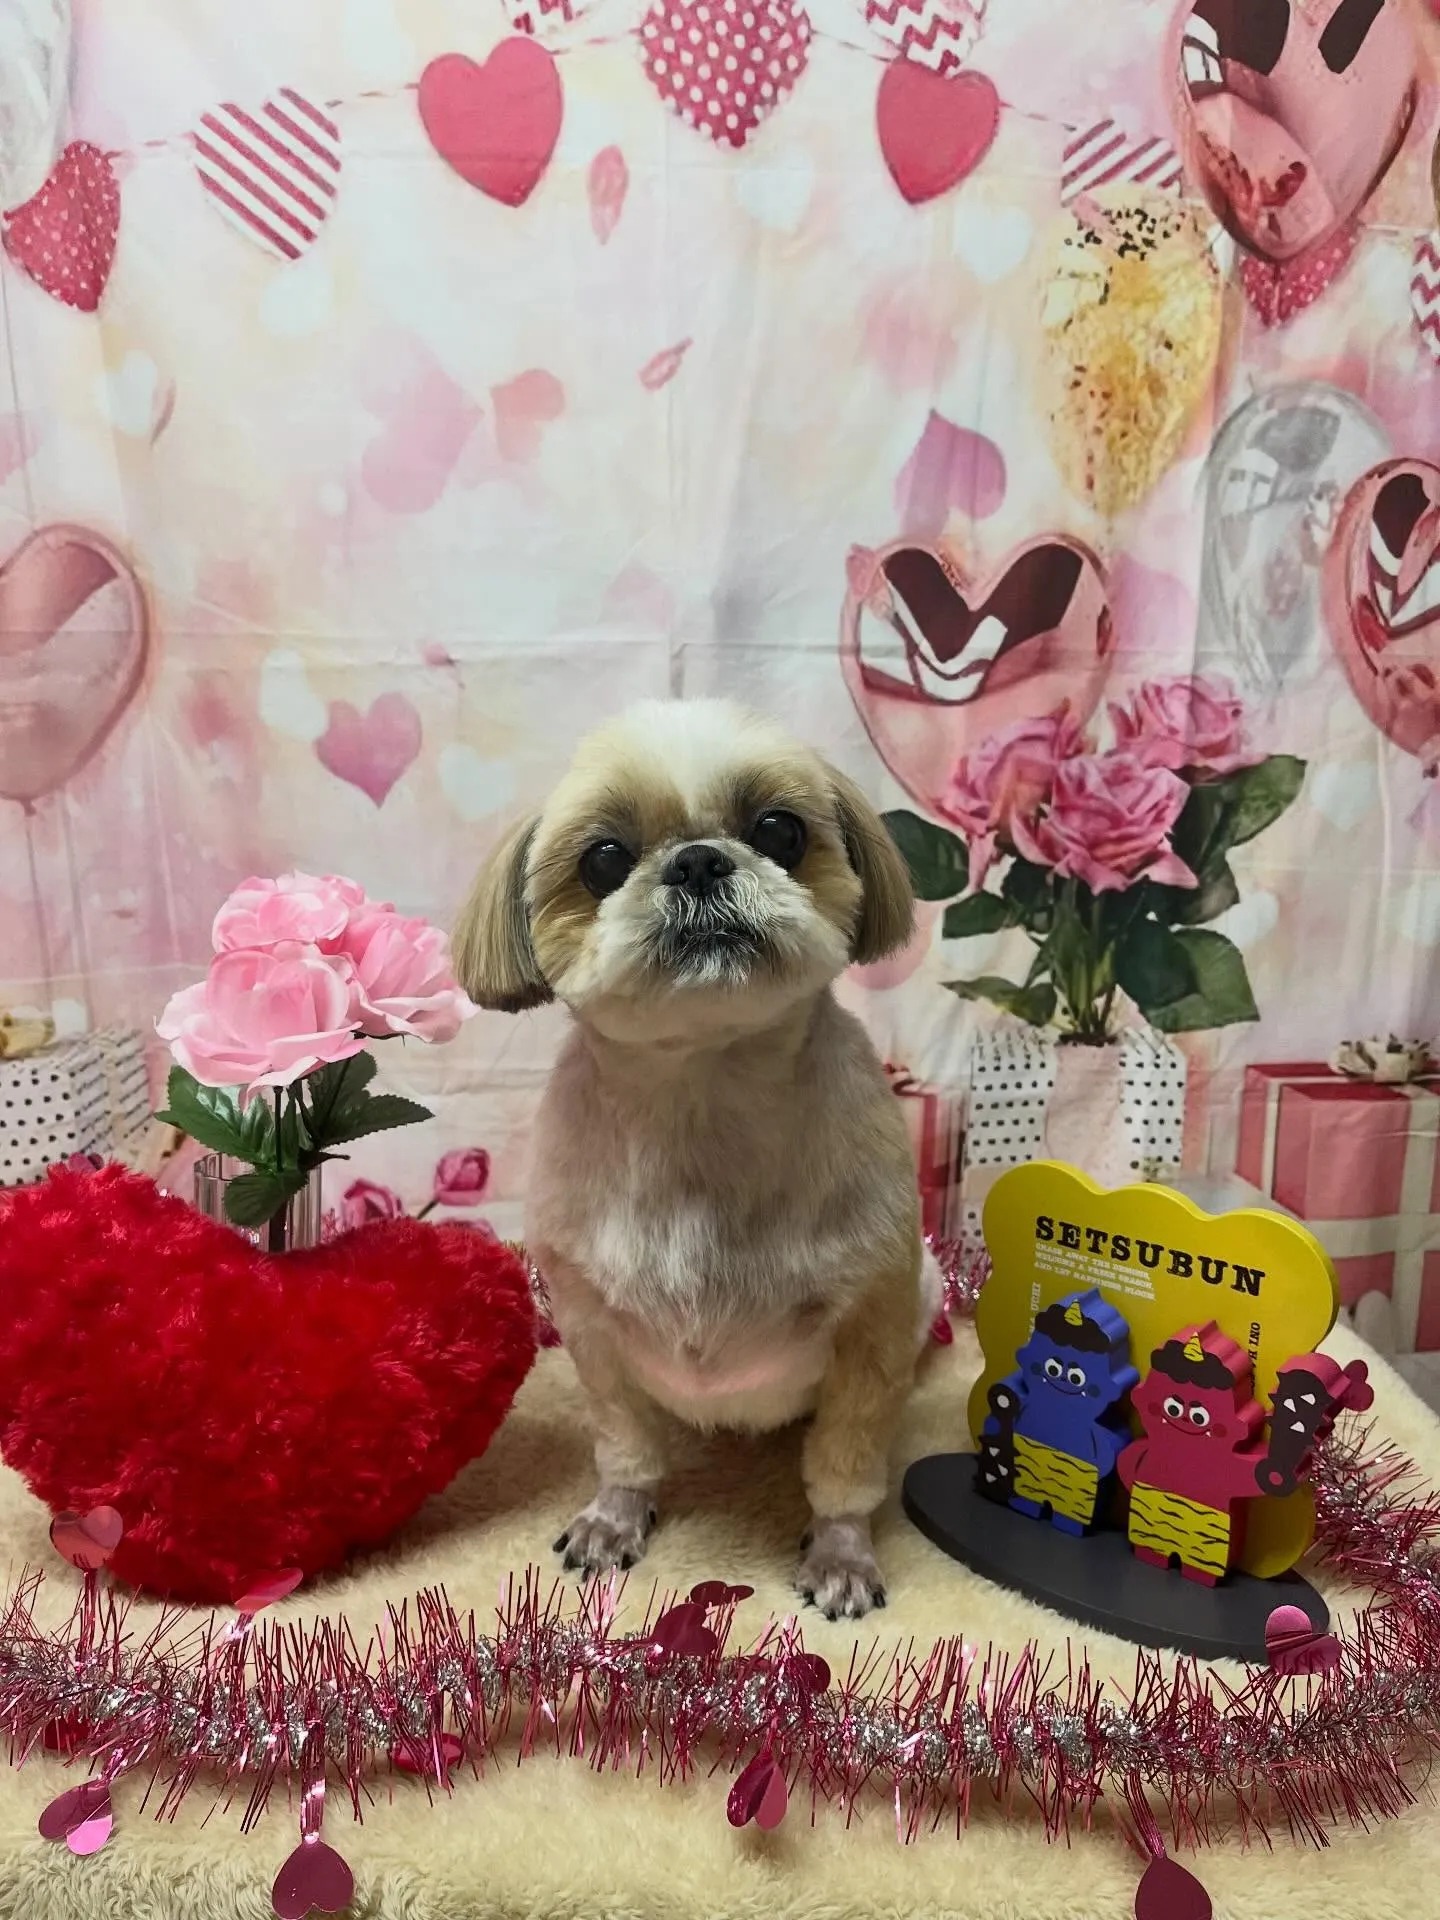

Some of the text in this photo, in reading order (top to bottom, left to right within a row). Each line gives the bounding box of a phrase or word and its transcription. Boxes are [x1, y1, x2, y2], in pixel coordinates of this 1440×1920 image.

[1036, 1216, 1265, 1296] SETSUBUN
[1031, 1282, 1041, 1312] UCHI
[1249, 1322, 1261, 1346] ONI
